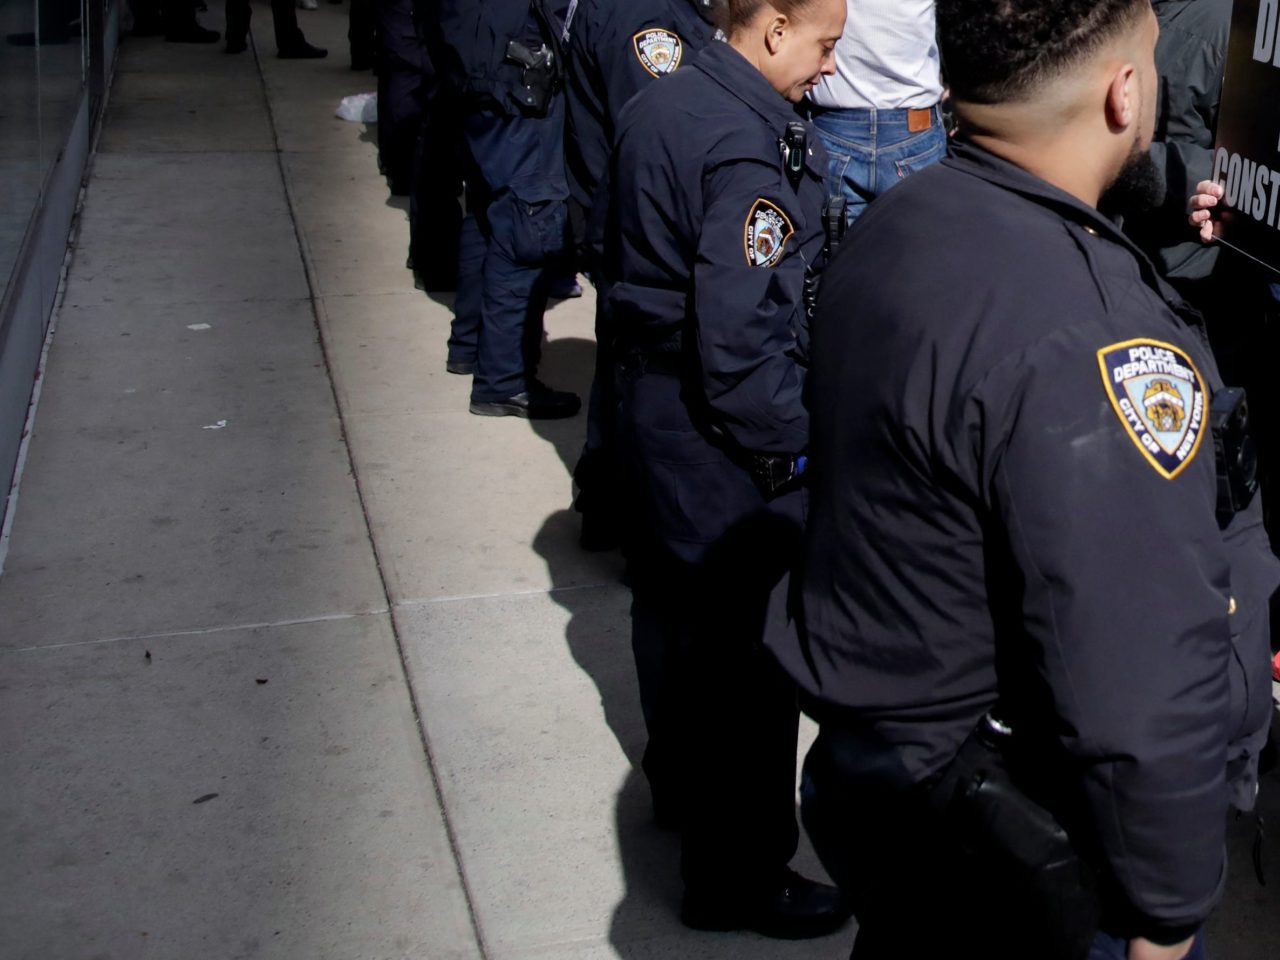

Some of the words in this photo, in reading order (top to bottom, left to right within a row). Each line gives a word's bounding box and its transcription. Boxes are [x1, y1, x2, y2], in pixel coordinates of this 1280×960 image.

[1128, 346, 1177, 364] POLICE
[1113, 359, 1195, 383] DEPARTMENT
[1119, 397, 1146, 432] CITY
[1141, 432, 1161, 454] OF
[1175, 430, 1196, 461] NEW
[1189, 391, 1203, 430] YORK
